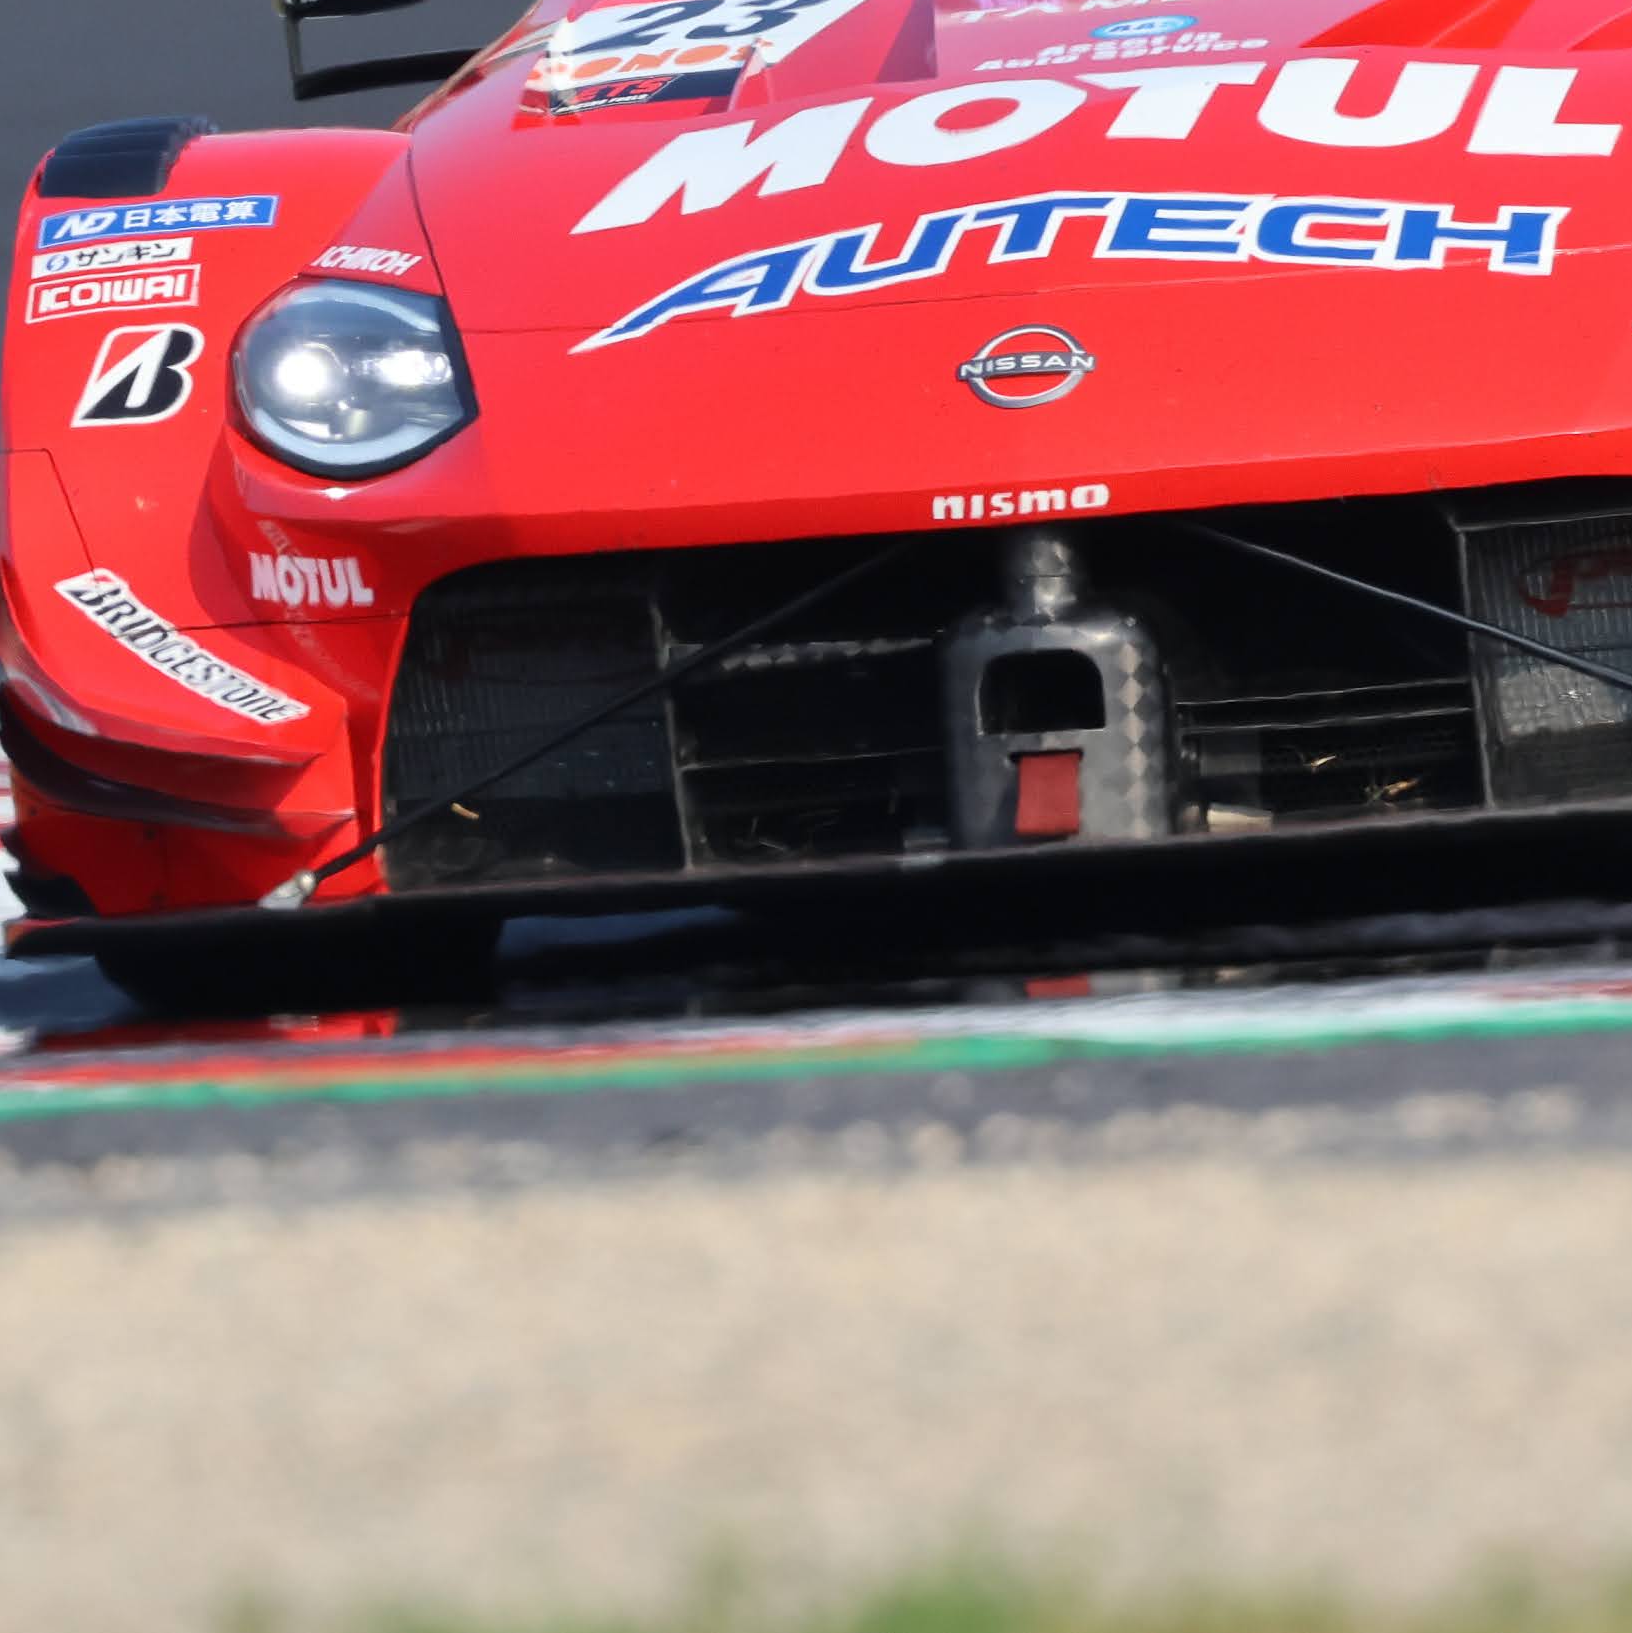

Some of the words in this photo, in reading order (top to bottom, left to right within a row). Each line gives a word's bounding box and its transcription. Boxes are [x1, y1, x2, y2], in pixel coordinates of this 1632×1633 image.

[570, 58, 1623, 235] MOTUL
[123, 199, 255, 229] 日本電算
[311, 246, 423, 276] ICHIKOH
[568, 190, 1572, 355] AUTECH
[959, 351, 1095, 379] NISSAN
[248, 552, 375, 608] MOTUL
[68, 571, 303, 722] BRIDGESTONE
